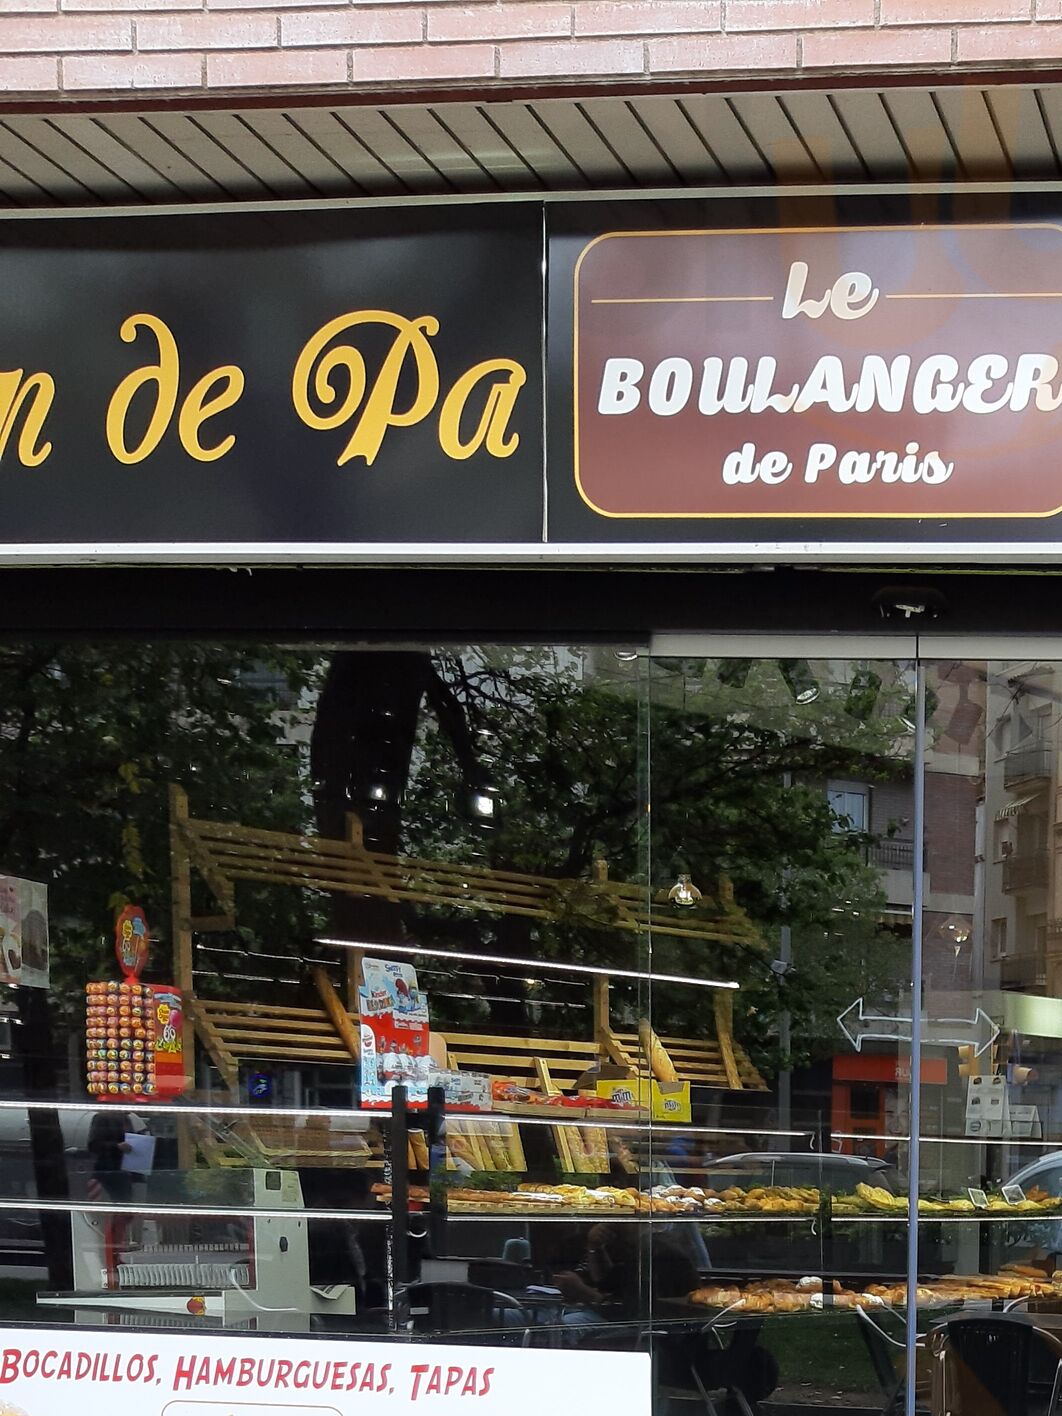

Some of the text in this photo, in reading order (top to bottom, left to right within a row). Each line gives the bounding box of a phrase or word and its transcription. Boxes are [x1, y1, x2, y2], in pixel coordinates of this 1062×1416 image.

[781, 261, 879, 319] Le
[106, 313, 245, 465] de
[292, 309, 527, 466] Pa
[722, 441, 955, 486] de Paris
[0, 1349, 494, 1400] BOCADILLOS, HAMBURGUESAS, TAPAS
